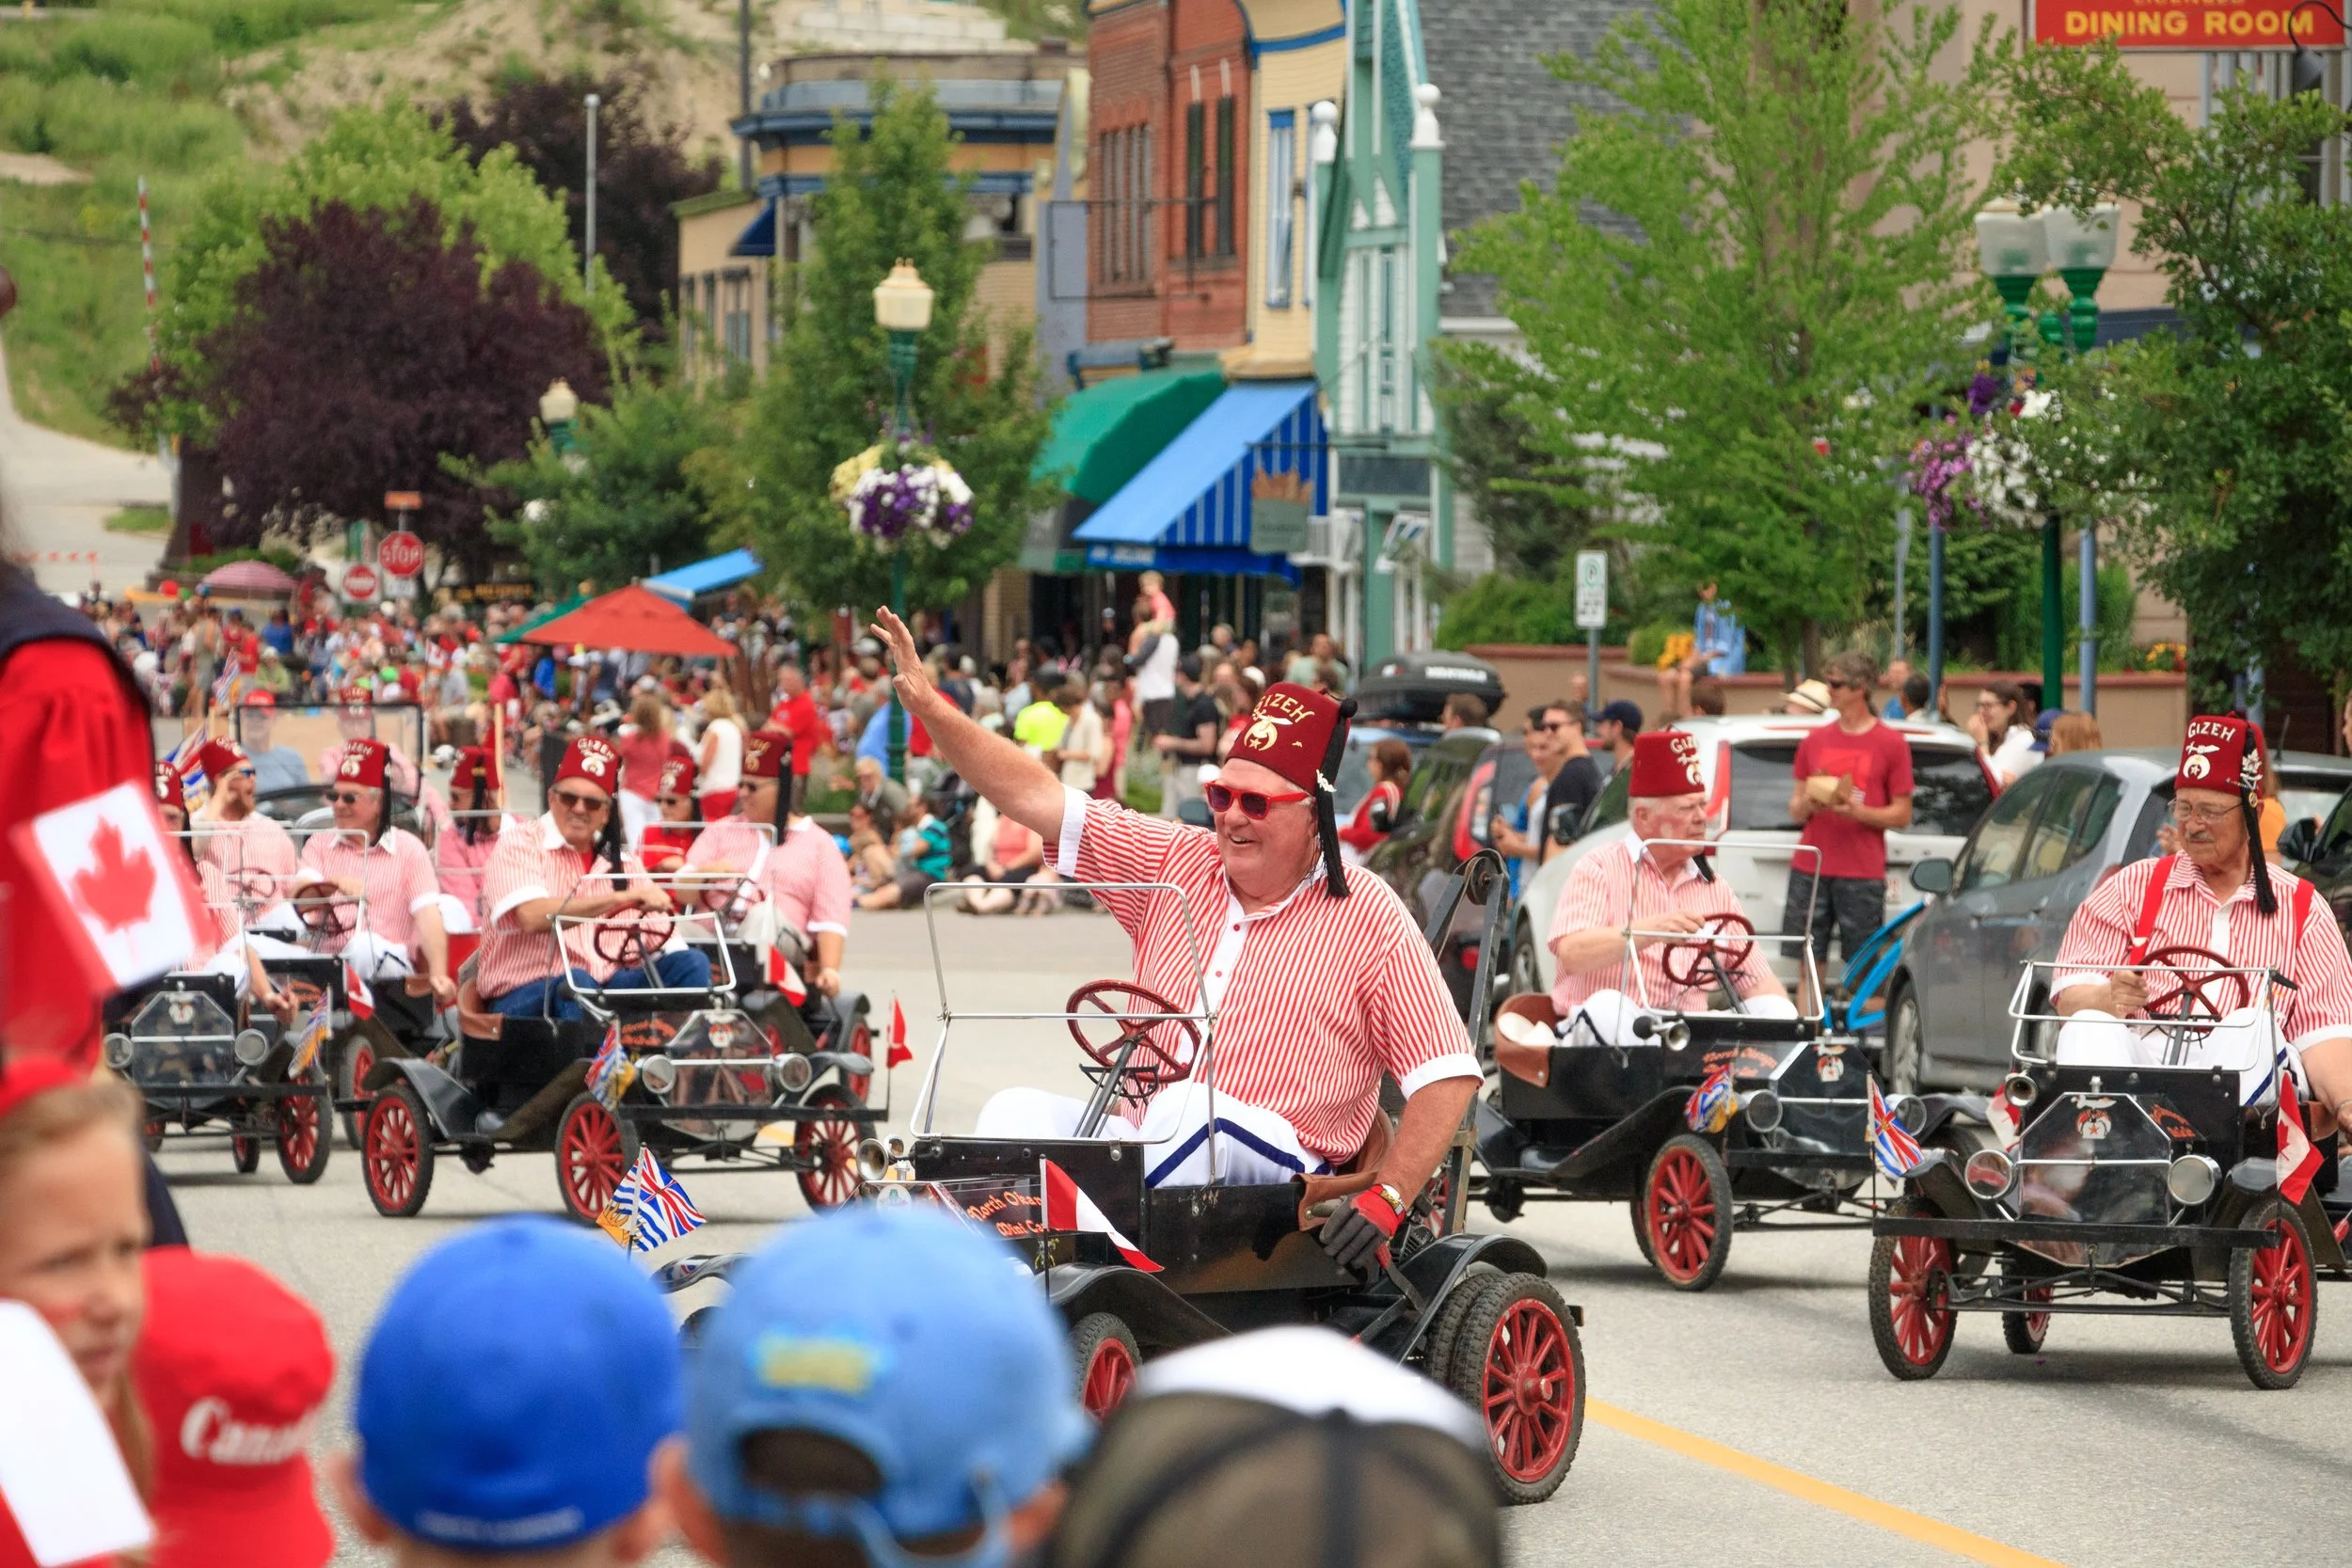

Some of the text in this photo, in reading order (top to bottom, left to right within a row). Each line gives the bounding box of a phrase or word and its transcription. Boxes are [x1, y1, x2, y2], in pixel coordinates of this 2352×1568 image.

[2065, 10, 2314, 35] DINING ROOM
[381, 538, 420, 565] STOP
[2187, 721, 2236, 742] GIZEH
[1670, 736, 1698, 753] GIZ
[966, 1190, 1042, 1223] North Okan
[995, 1219, 1050, 1238] Mini Ca
